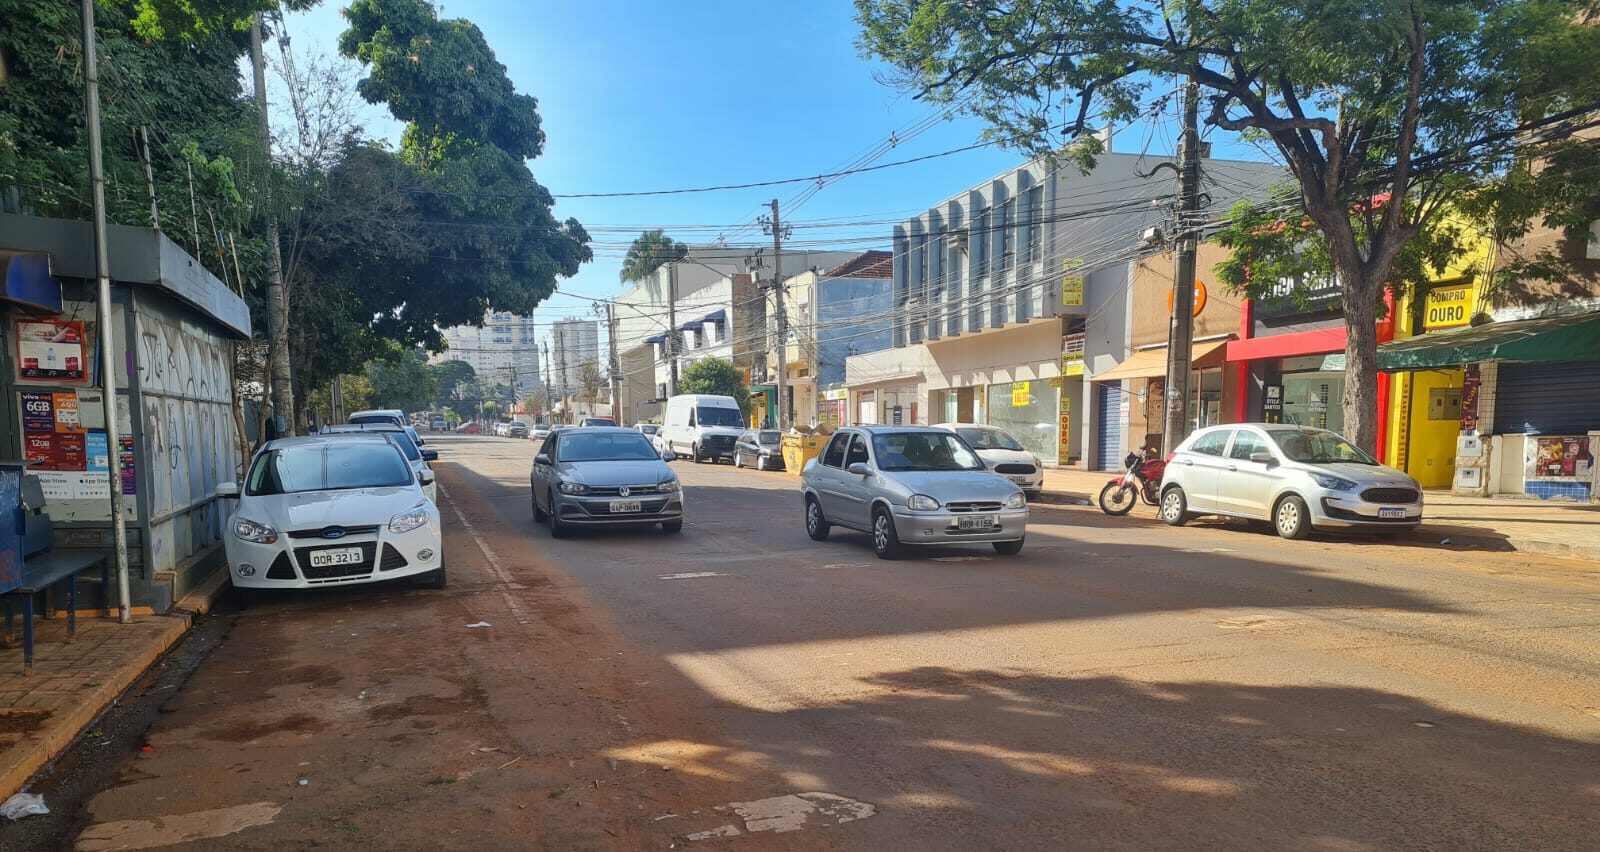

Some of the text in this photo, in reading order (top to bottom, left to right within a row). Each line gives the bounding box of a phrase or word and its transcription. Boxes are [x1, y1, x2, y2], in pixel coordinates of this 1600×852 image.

[1430, 290, 1466, 303] COMPRO
[1429, 305, 1464, 323] OURO
[26, 401, 50, 412] 6GB
[1061, 416, 1069, 445] OURO
